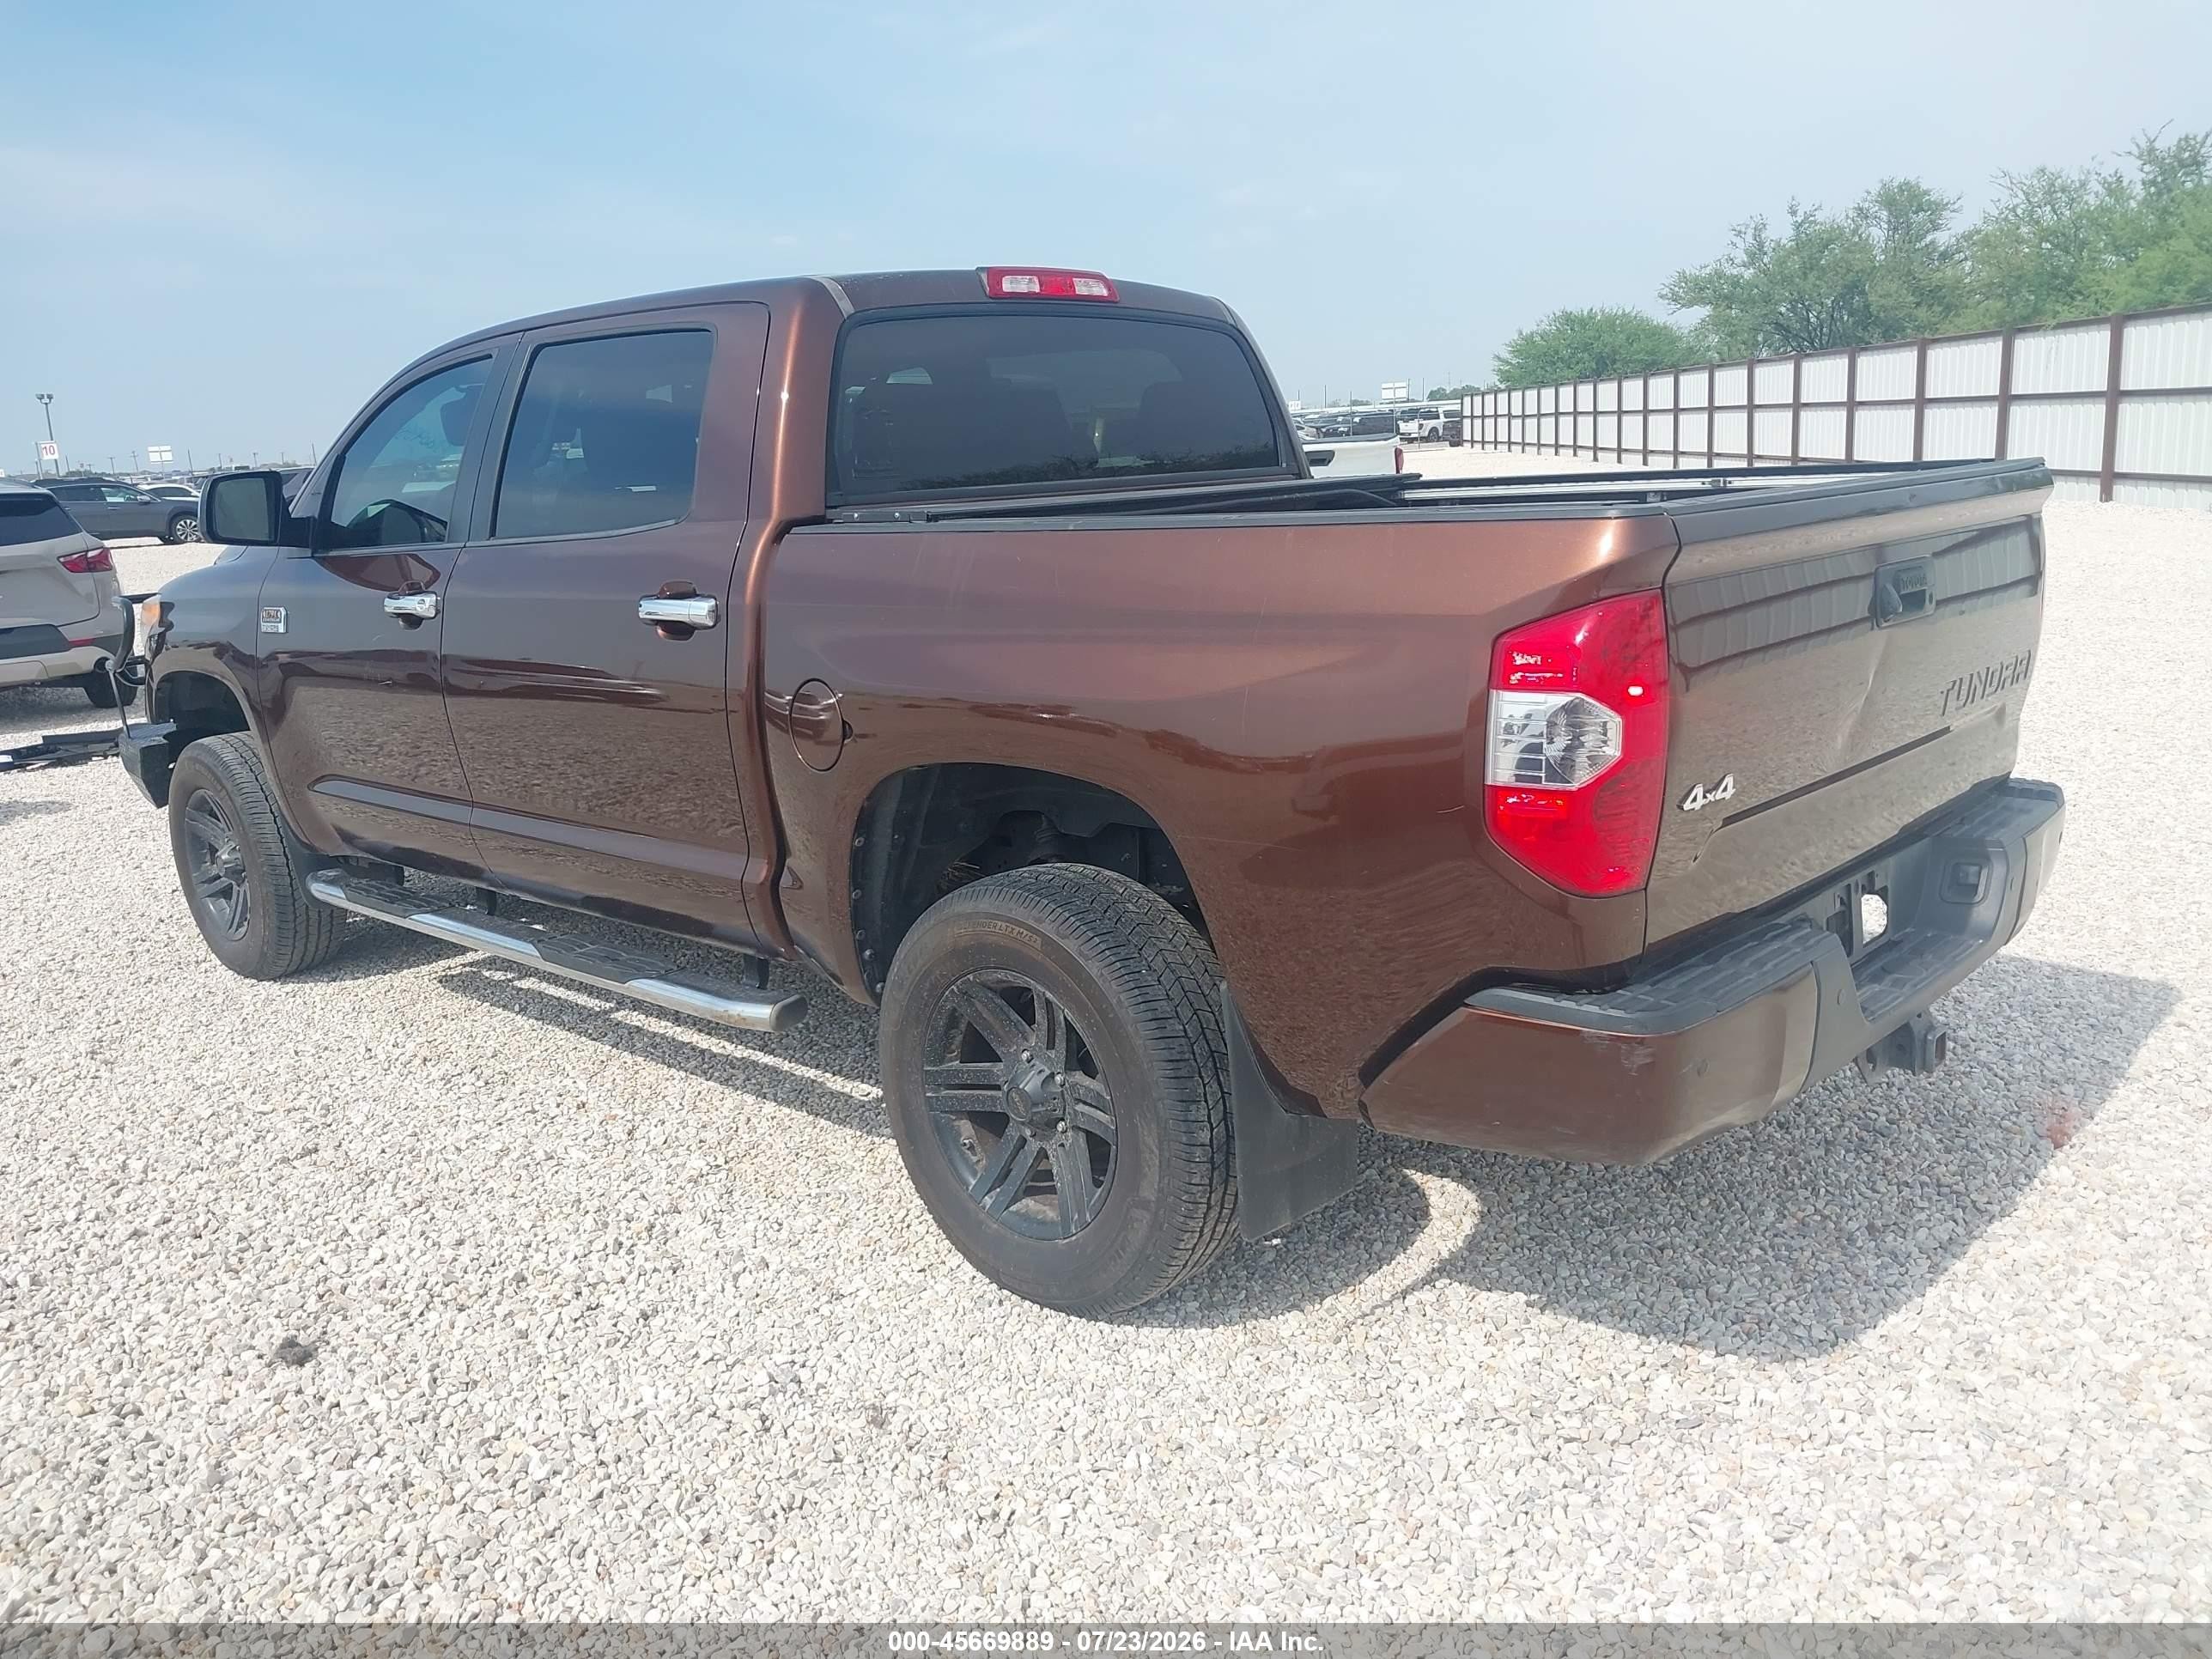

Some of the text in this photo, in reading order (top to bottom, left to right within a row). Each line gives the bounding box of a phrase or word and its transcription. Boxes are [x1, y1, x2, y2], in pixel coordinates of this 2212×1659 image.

[41, 445, 55, 455] 10
[1940, 649, 2032, 716] TUNDRA
[1679, 773, 1735, 811] 4x4
[999, 923, 1016, 934] LTX
